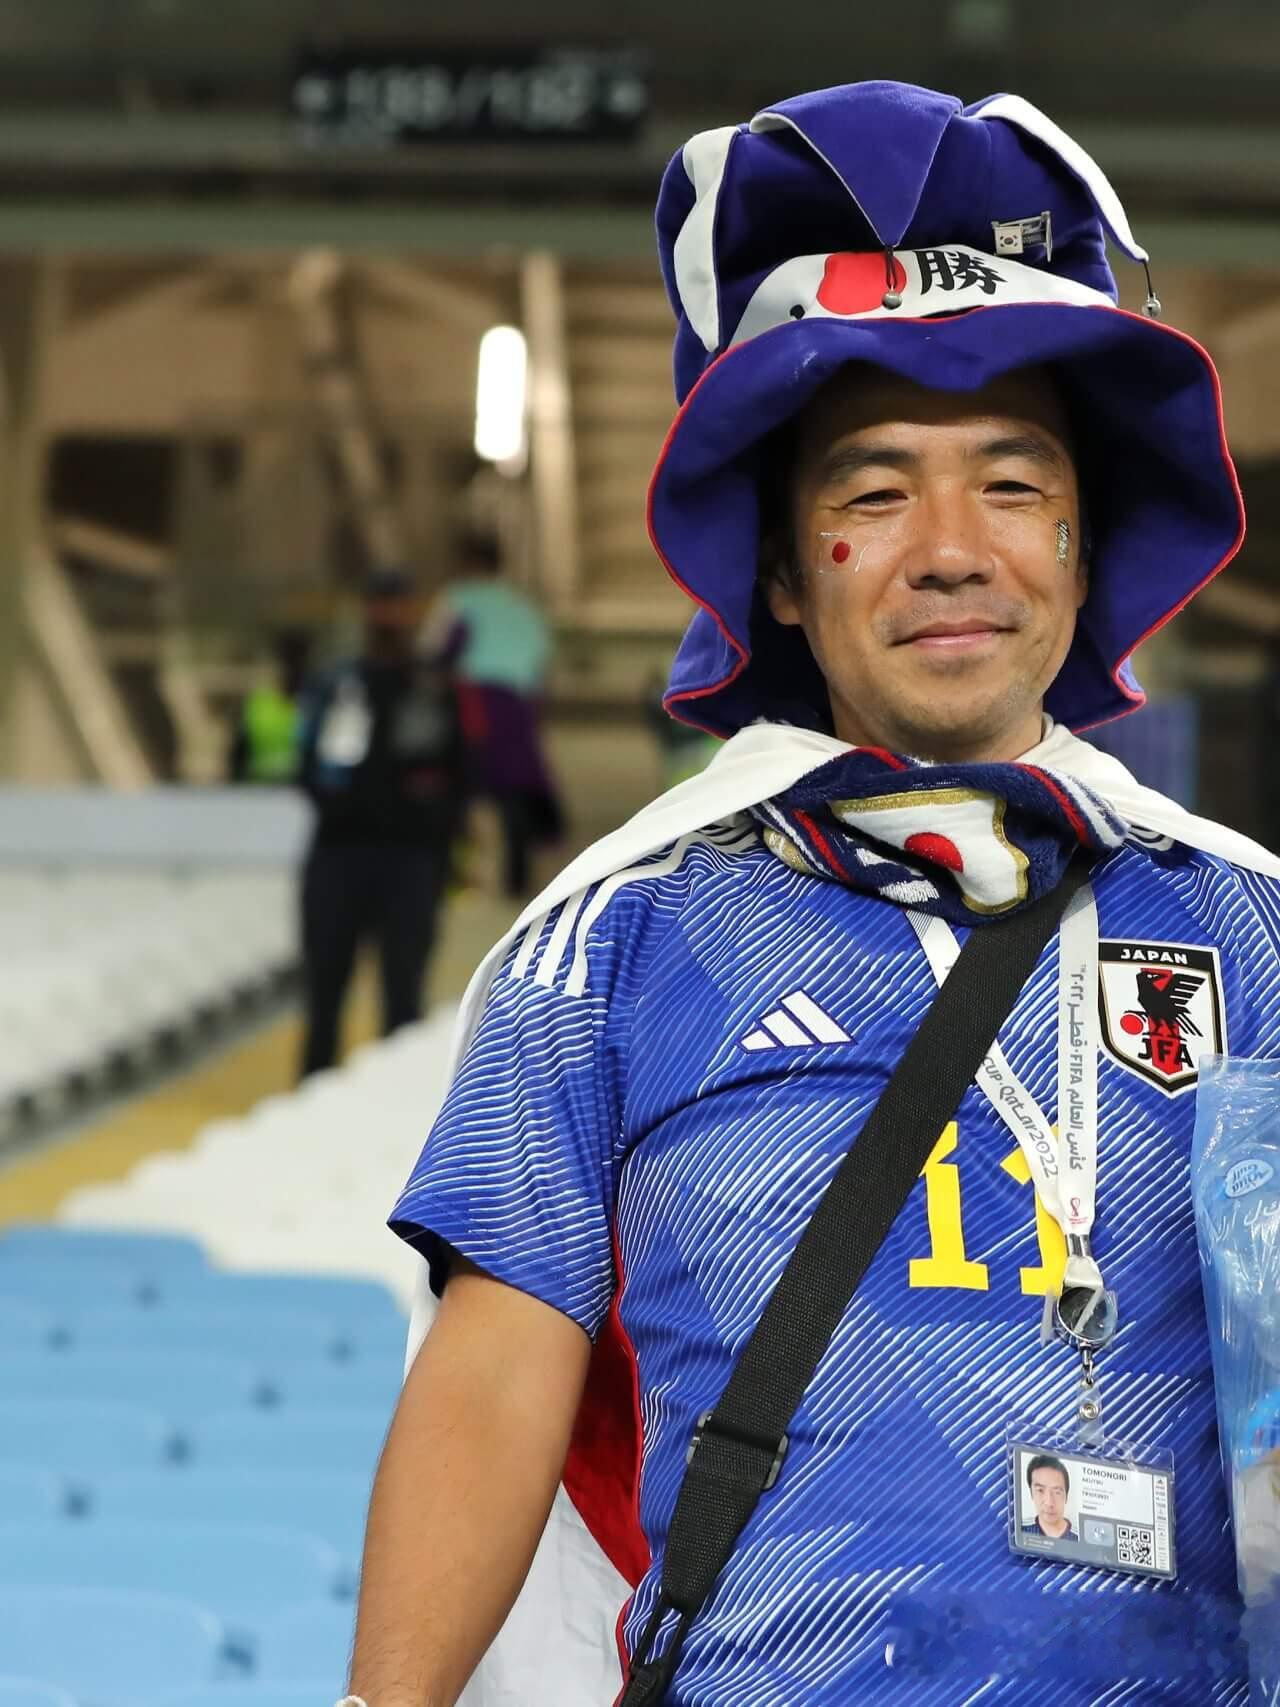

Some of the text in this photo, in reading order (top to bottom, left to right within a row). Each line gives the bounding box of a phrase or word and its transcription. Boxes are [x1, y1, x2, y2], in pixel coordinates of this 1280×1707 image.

[912, 249, 1009, 297] 勝
[1120, 948, 1188, 965] JAPAN
[1137, 1037, 1195, 1069] JFA
